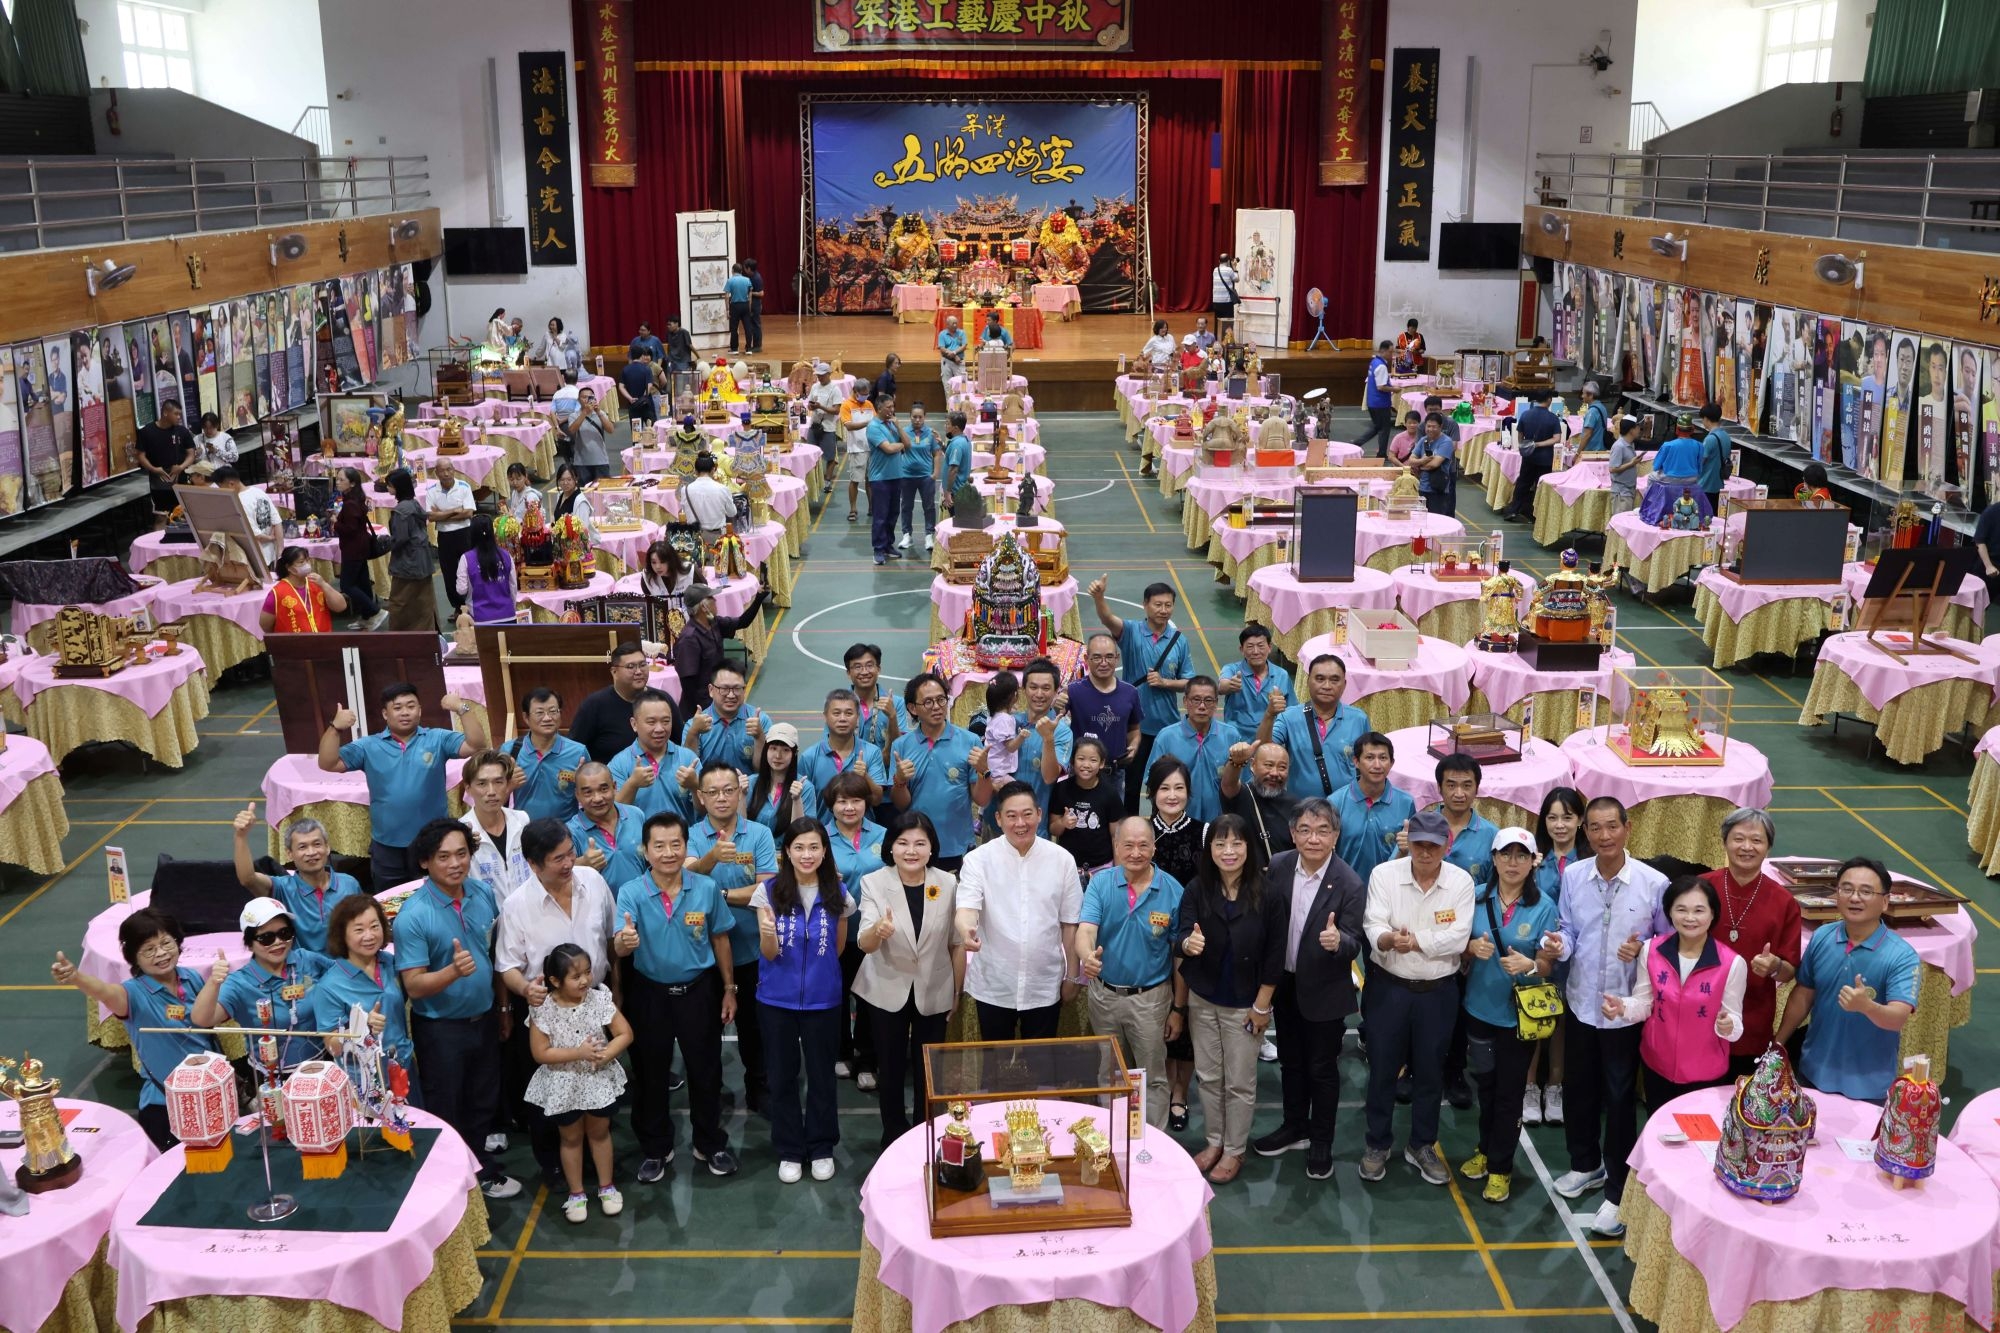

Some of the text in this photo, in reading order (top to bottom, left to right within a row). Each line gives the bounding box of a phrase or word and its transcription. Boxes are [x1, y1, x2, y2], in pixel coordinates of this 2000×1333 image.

[853, 0, 1092, 34] 笨港工藝慶中秋
[599, 3, 622, 162] 水巷百川有容乃大
[1335, 2, 1358, 162] 竹本清心巧奪天工
[532, 66, 567, 249] 法古今完人
[873, 134, 1086, 189] 五湖四海宴
[1397, 62, 1428, 248] 養天地正氣
[817, 908, 828, 956] 雲林縣政府
[1697, 982, 1712, 1018] 鎮長
